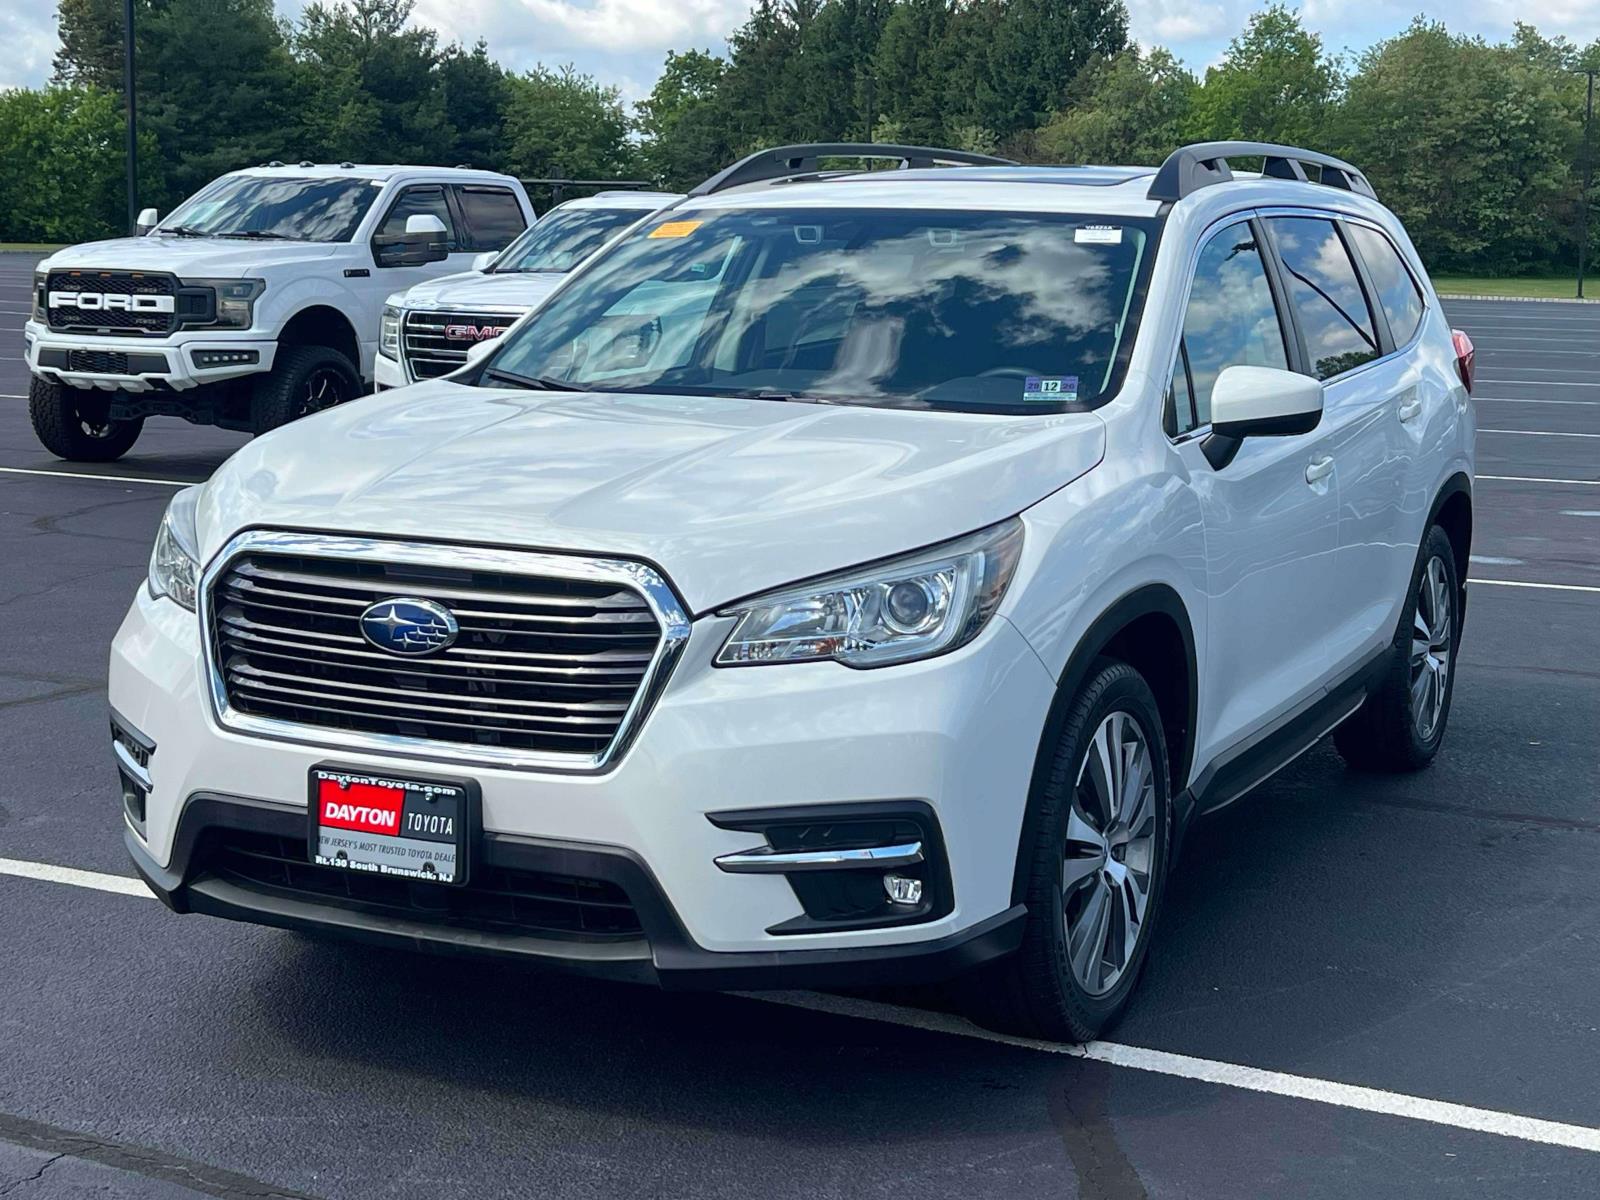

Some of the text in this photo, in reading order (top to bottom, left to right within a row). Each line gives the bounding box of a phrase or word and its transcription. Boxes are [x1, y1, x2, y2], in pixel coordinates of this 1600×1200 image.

[48, 291, 175, 313] FORD
[1044, 381, 1058, 391] 12
[317, 771, 456, 796] DaytonToyota.com
[325, 802, 396, 827] DAYTON
[407, 812, 453, 835] TOYOTA
[319, 836, 456, 863] EW JERSEY'S MOST TRUSTED TOYOTA DEALE
[350, 860, 379, 872] South
[380, 864, 437, 880] Brunswick,
[438, 872, 453, 882] NJ
